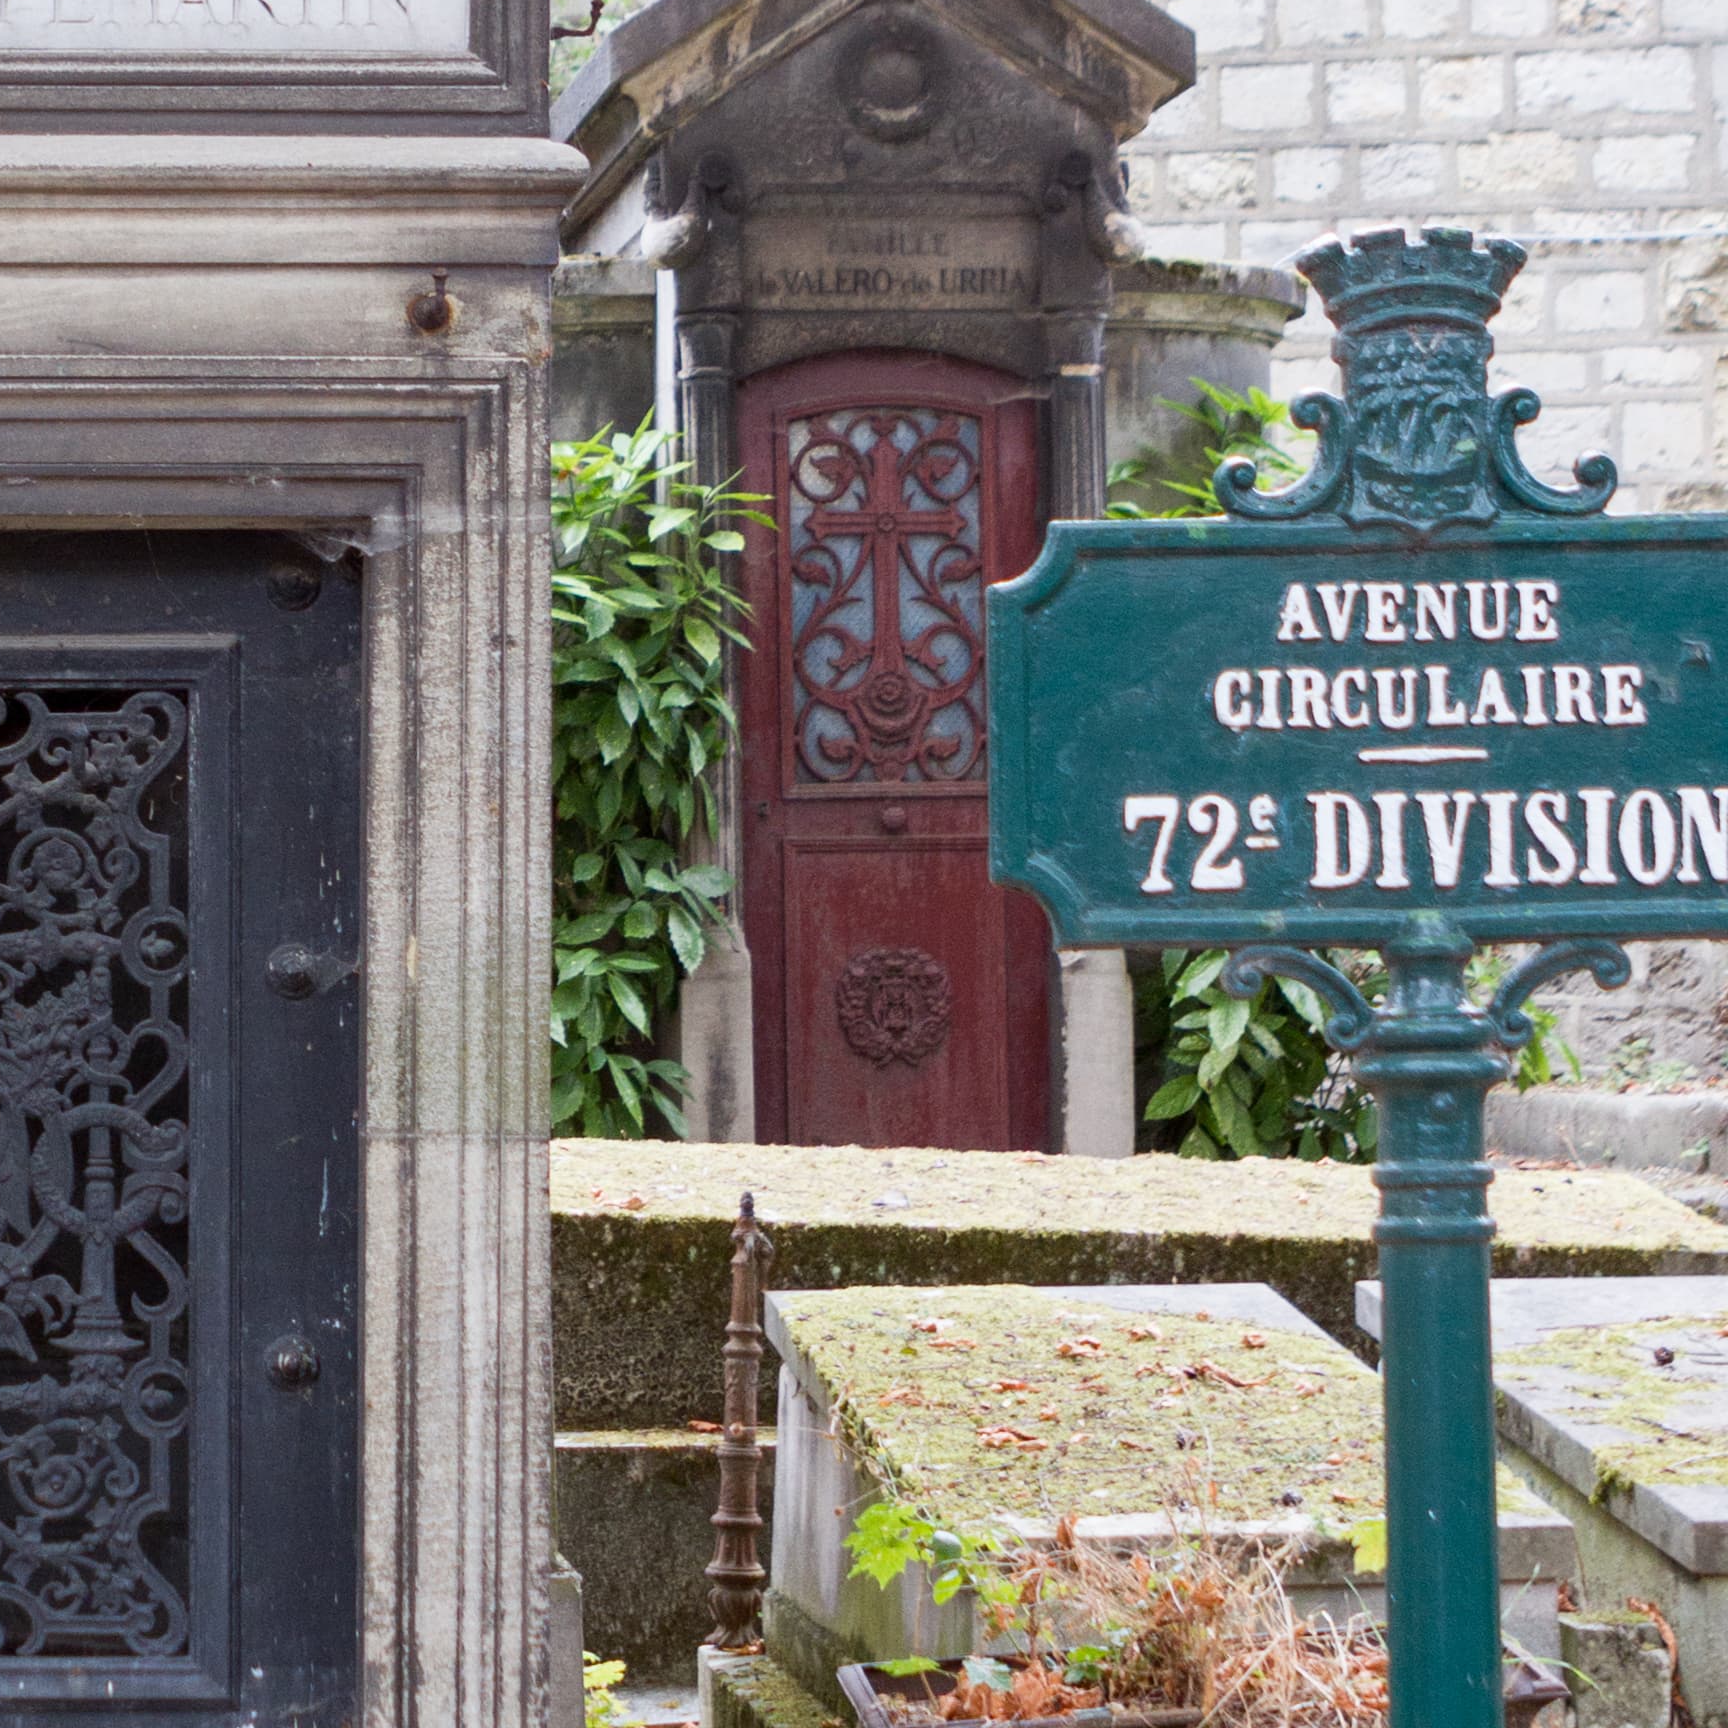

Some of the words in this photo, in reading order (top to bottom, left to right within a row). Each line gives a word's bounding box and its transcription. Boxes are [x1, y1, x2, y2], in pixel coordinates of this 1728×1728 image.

[777, 267, 894, 294] VALERO
[1277, 580, 1561, 643] AVENUE
[1213, 665, 1647, 730] CIRCULAIRE
[1305, 788, 1728, 890] DIVISION
